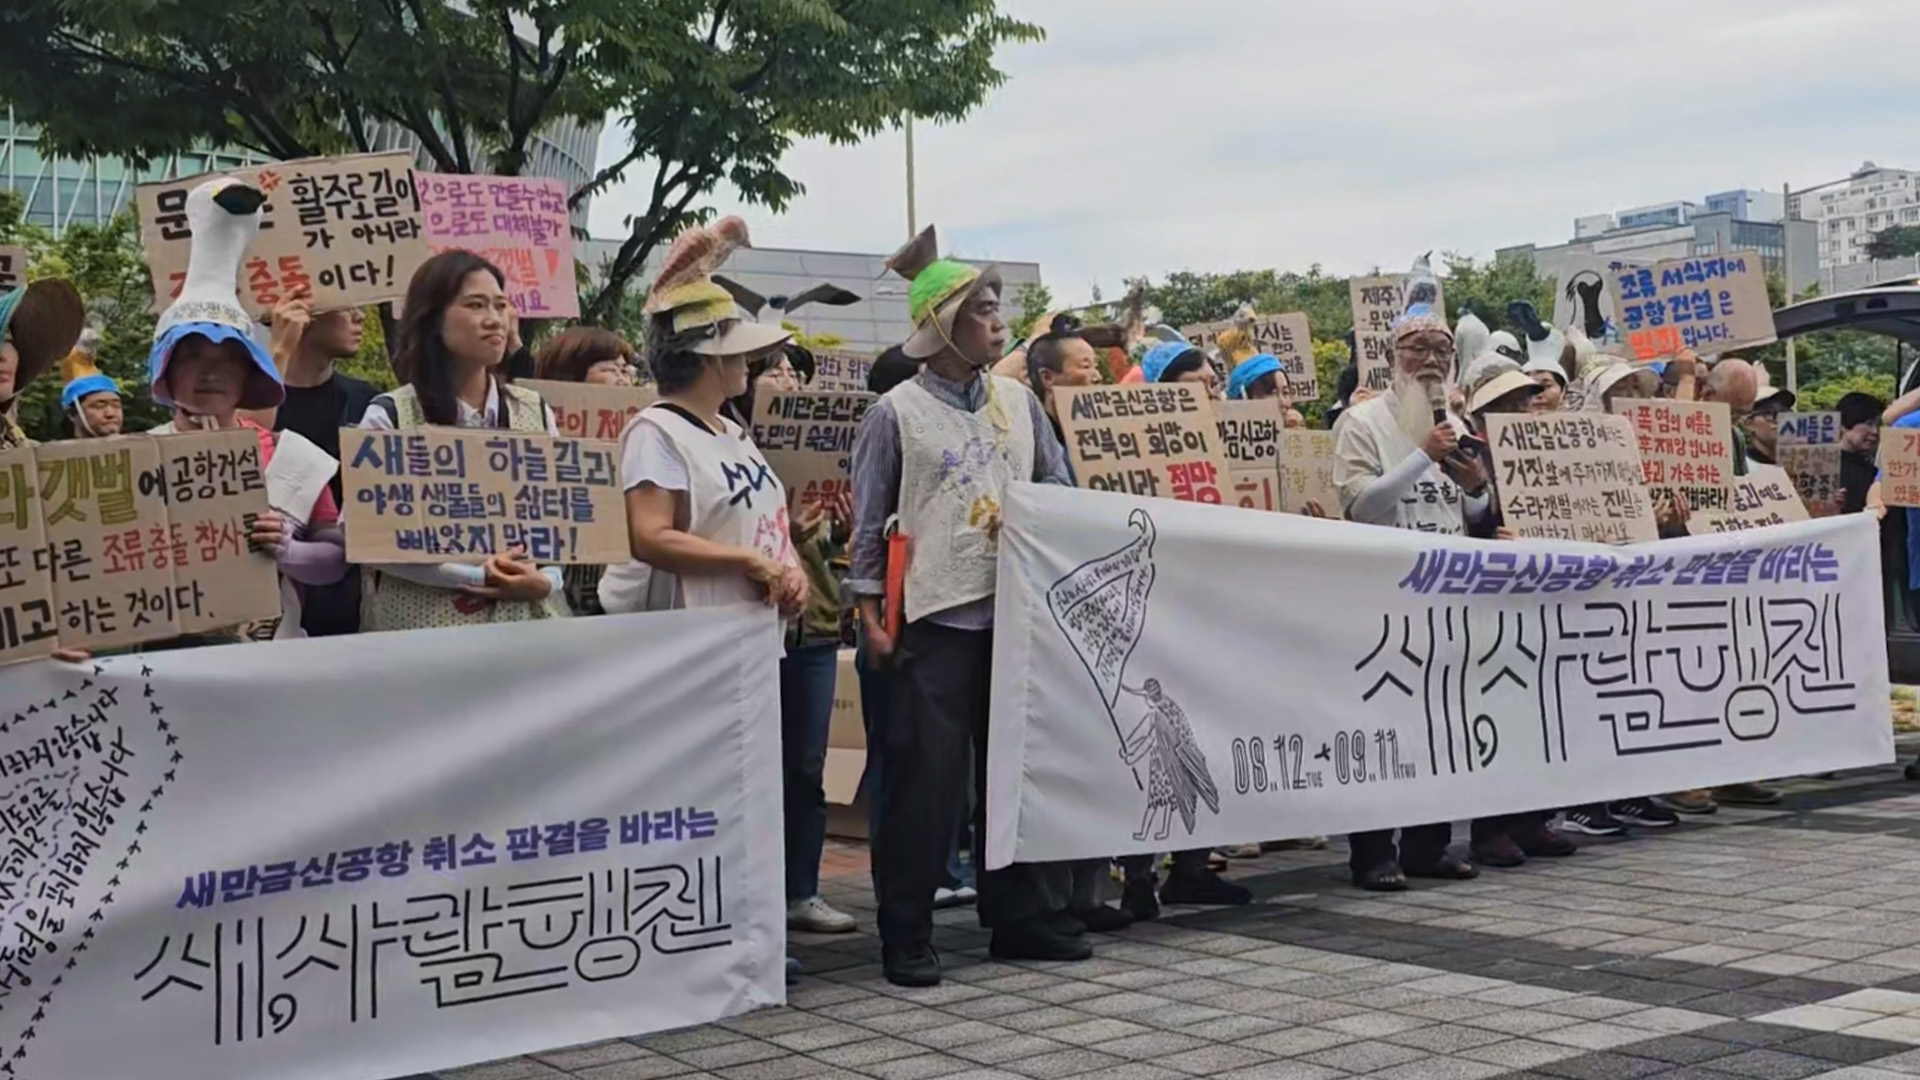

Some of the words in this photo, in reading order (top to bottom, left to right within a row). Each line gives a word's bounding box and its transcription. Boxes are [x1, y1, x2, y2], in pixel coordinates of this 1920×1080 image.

[351, 217, 421, 245] 아니라
[1618, 268, 1657, 300] 조류
[1661, 257, 1747, 287] 서식지에
[1070, 387, 1199, 421] 새만금신공항은
[1073, 429, 1142, 462] 전북의
[1780, 414, 1834, 445] 새들은
[351, 435, 466, 478] 새들의
[514, 484, 595, 523] 삶터를
[34, 539, 92, 583] 다른
[1398, 547, 1619, 595] 새만금신공항
[1611, 556, 1678, 587] 취소
[1671, 547, 1761, 587] 판결을
[1757, 543, 1841, 585] 바라는
[61, 597, 117, 635] 하는
[124, 579, 215, 628] 것이다.
[176, 838, 413, 910] 새만금신공항
[421, 830, 497, 872] 취소
[505, 816, 610, 861] 판결을
[618, 806, 719, 847] 바라는
